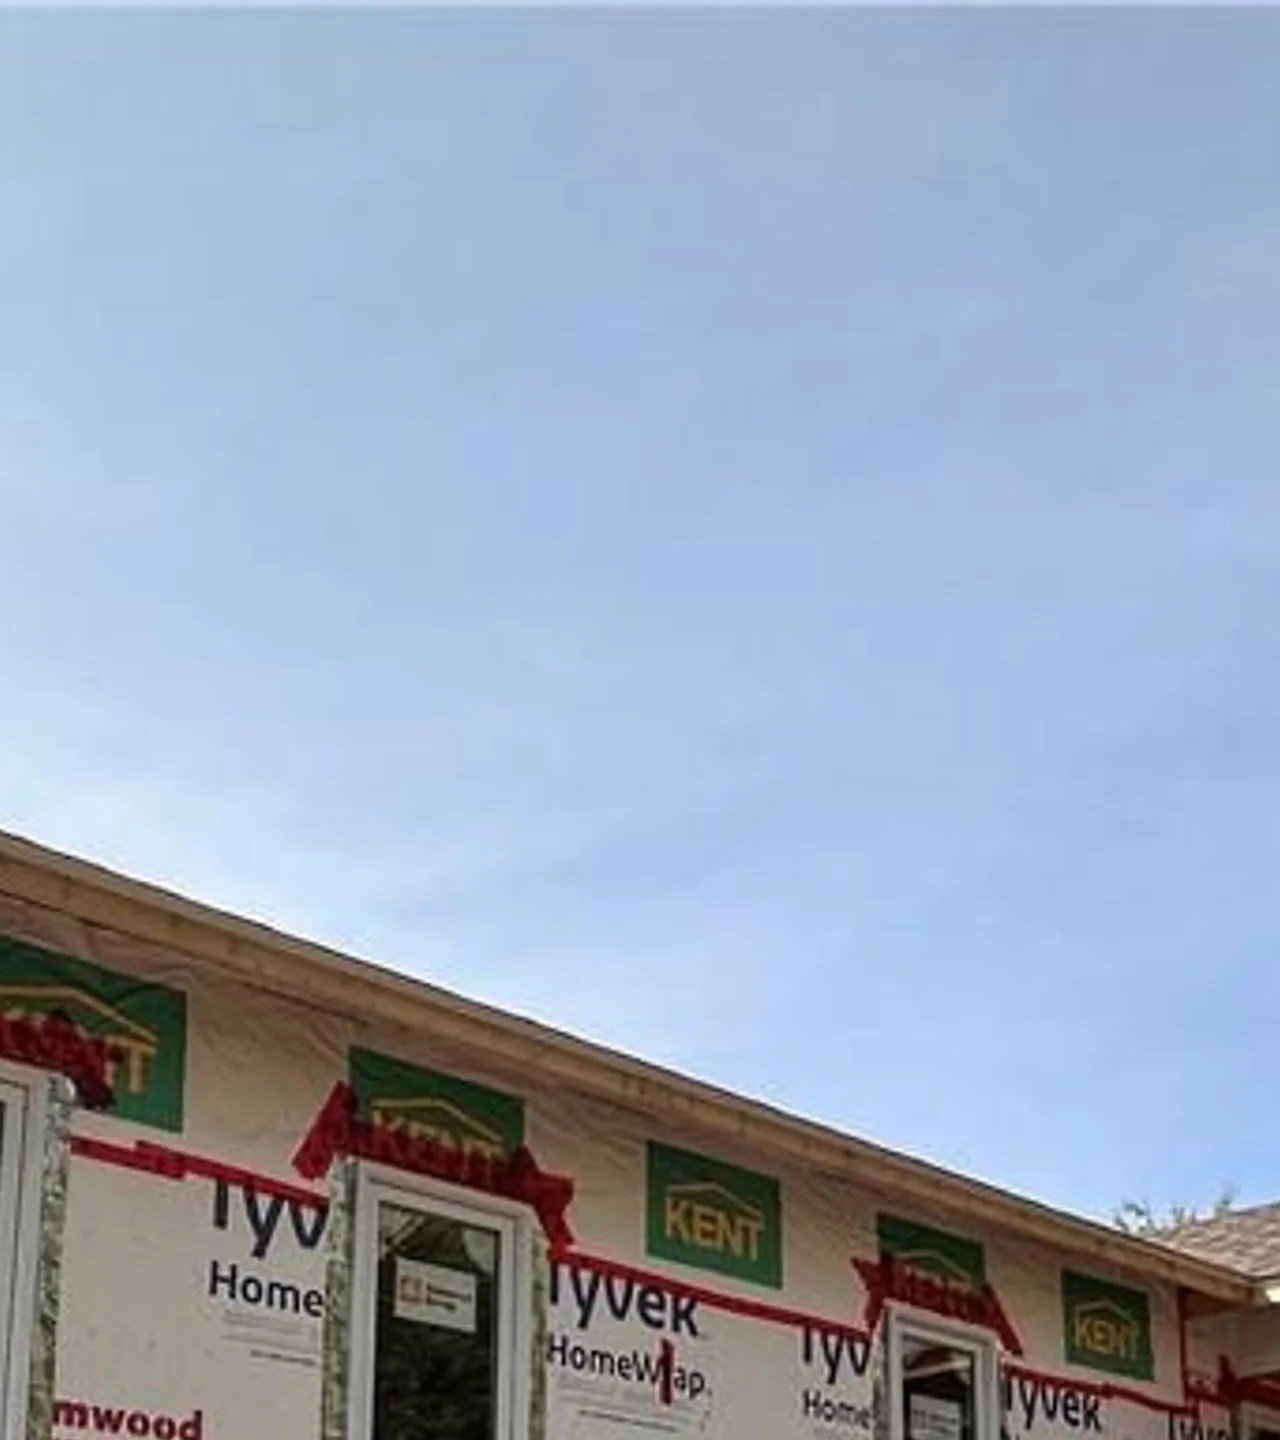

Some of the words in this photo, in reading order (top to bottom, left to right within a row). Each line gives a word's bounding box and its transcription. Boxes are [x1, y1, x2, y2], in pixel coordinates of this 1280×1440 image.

[665, 1198, 763, 1262] KENT
[209, 1260, 323, 1318] Home
[547, 1335, 708, 1398] HomeWap
